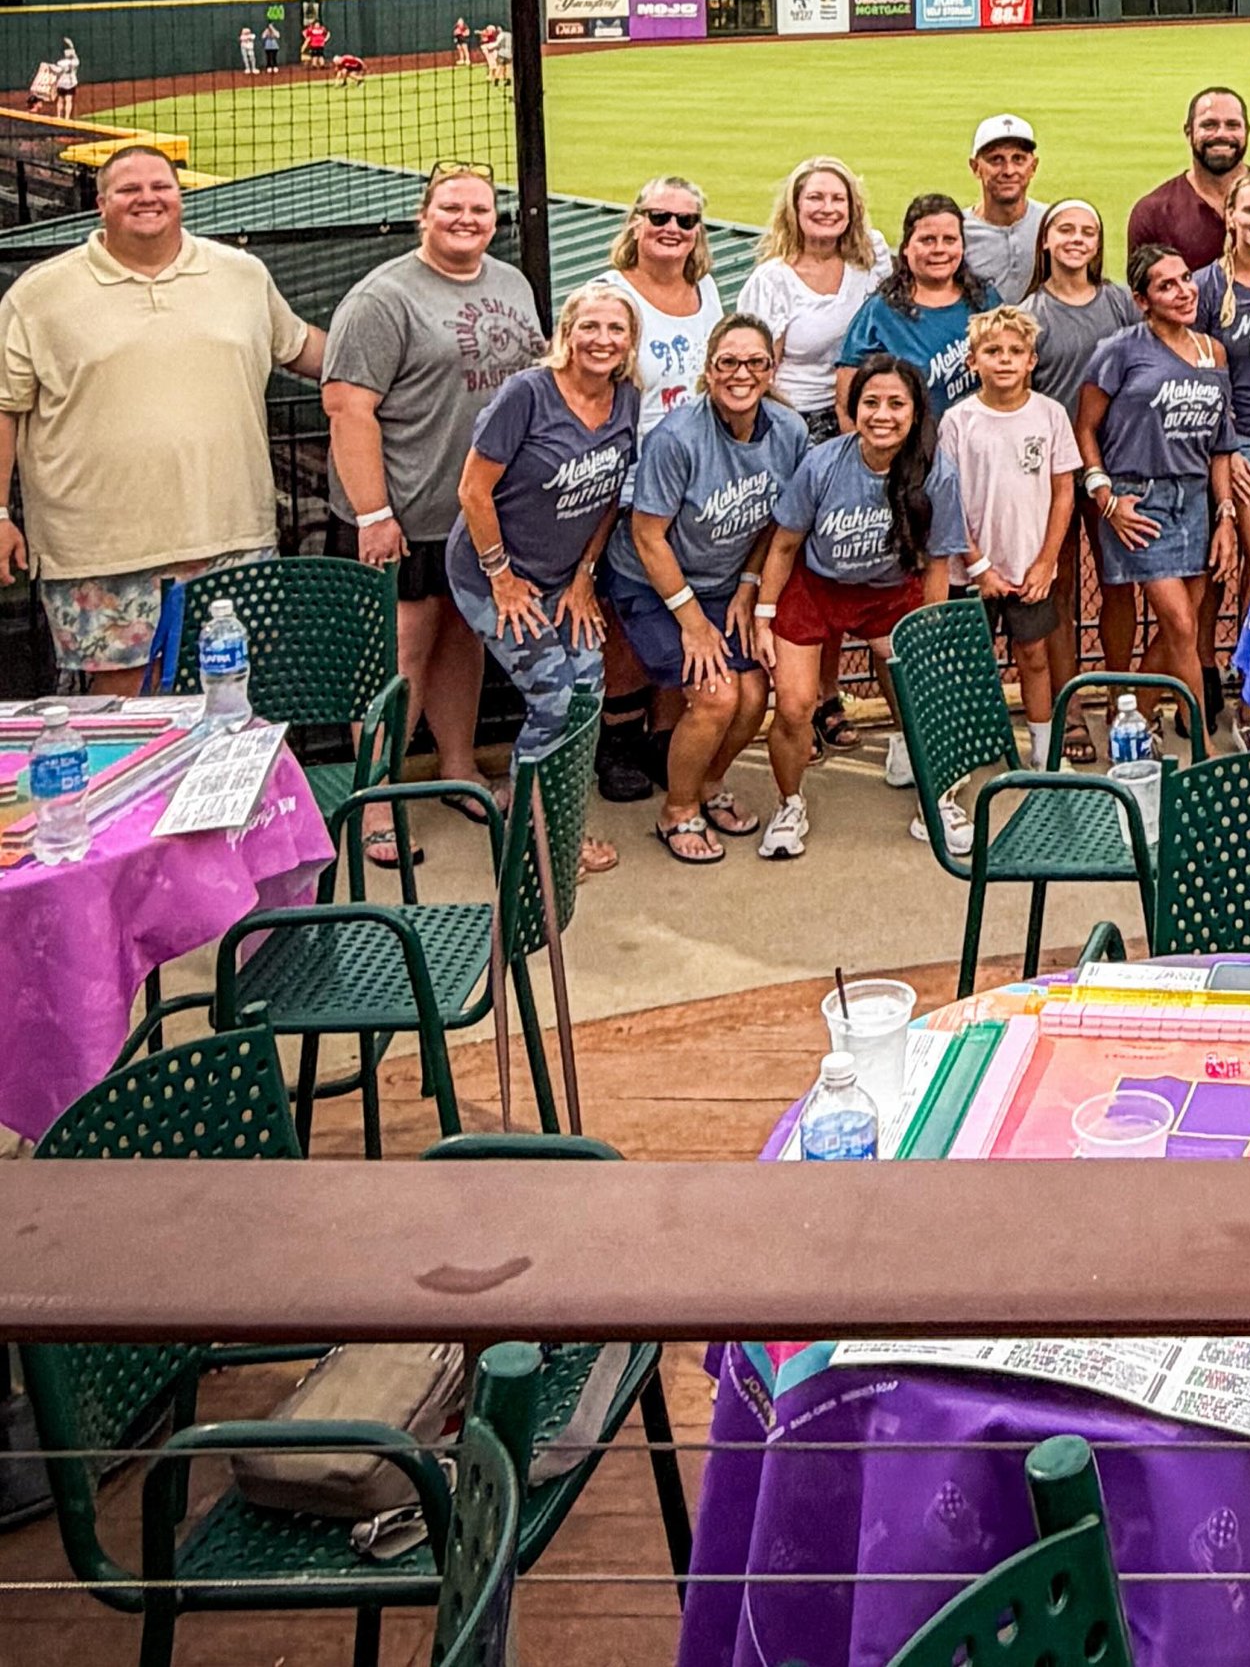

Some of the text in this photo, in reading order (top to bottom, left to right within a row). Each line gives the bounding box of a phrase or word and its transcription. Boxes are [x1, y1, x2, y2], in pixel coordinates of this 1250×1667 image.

[637, 3, 698, 16] MOJO
[1149, 379, 1221, 412] Mahjong
[542, 446, 621, 492] Mahjong
[695, 469, 771, 524] Mahjong
